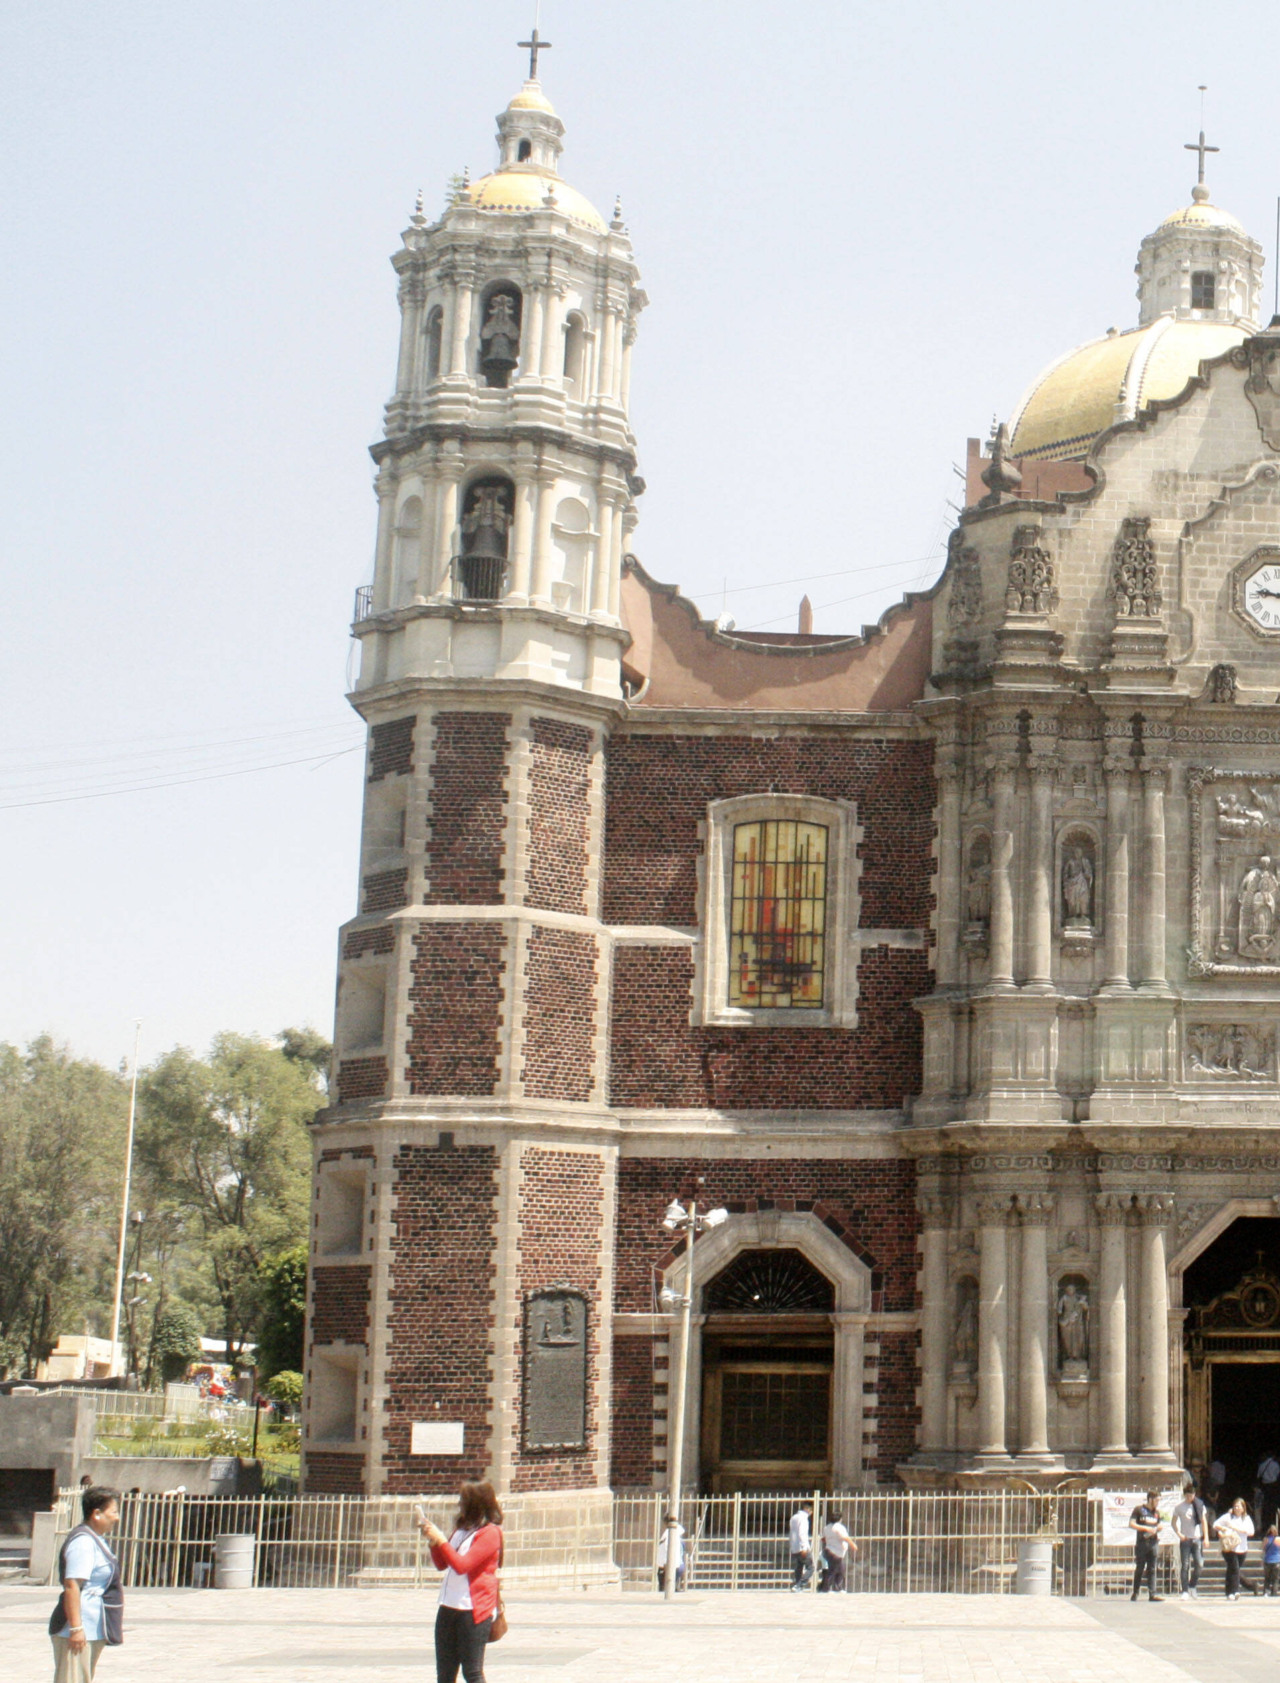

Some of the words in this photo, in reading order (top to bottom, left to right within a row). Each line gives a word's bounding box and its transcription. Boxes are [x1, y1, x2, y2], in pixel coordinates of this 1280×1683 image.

[1261, 571, 1271, 582] XI
[1253, 580, 1263, 589] X
[1274, 614, 1280, 625] VI
